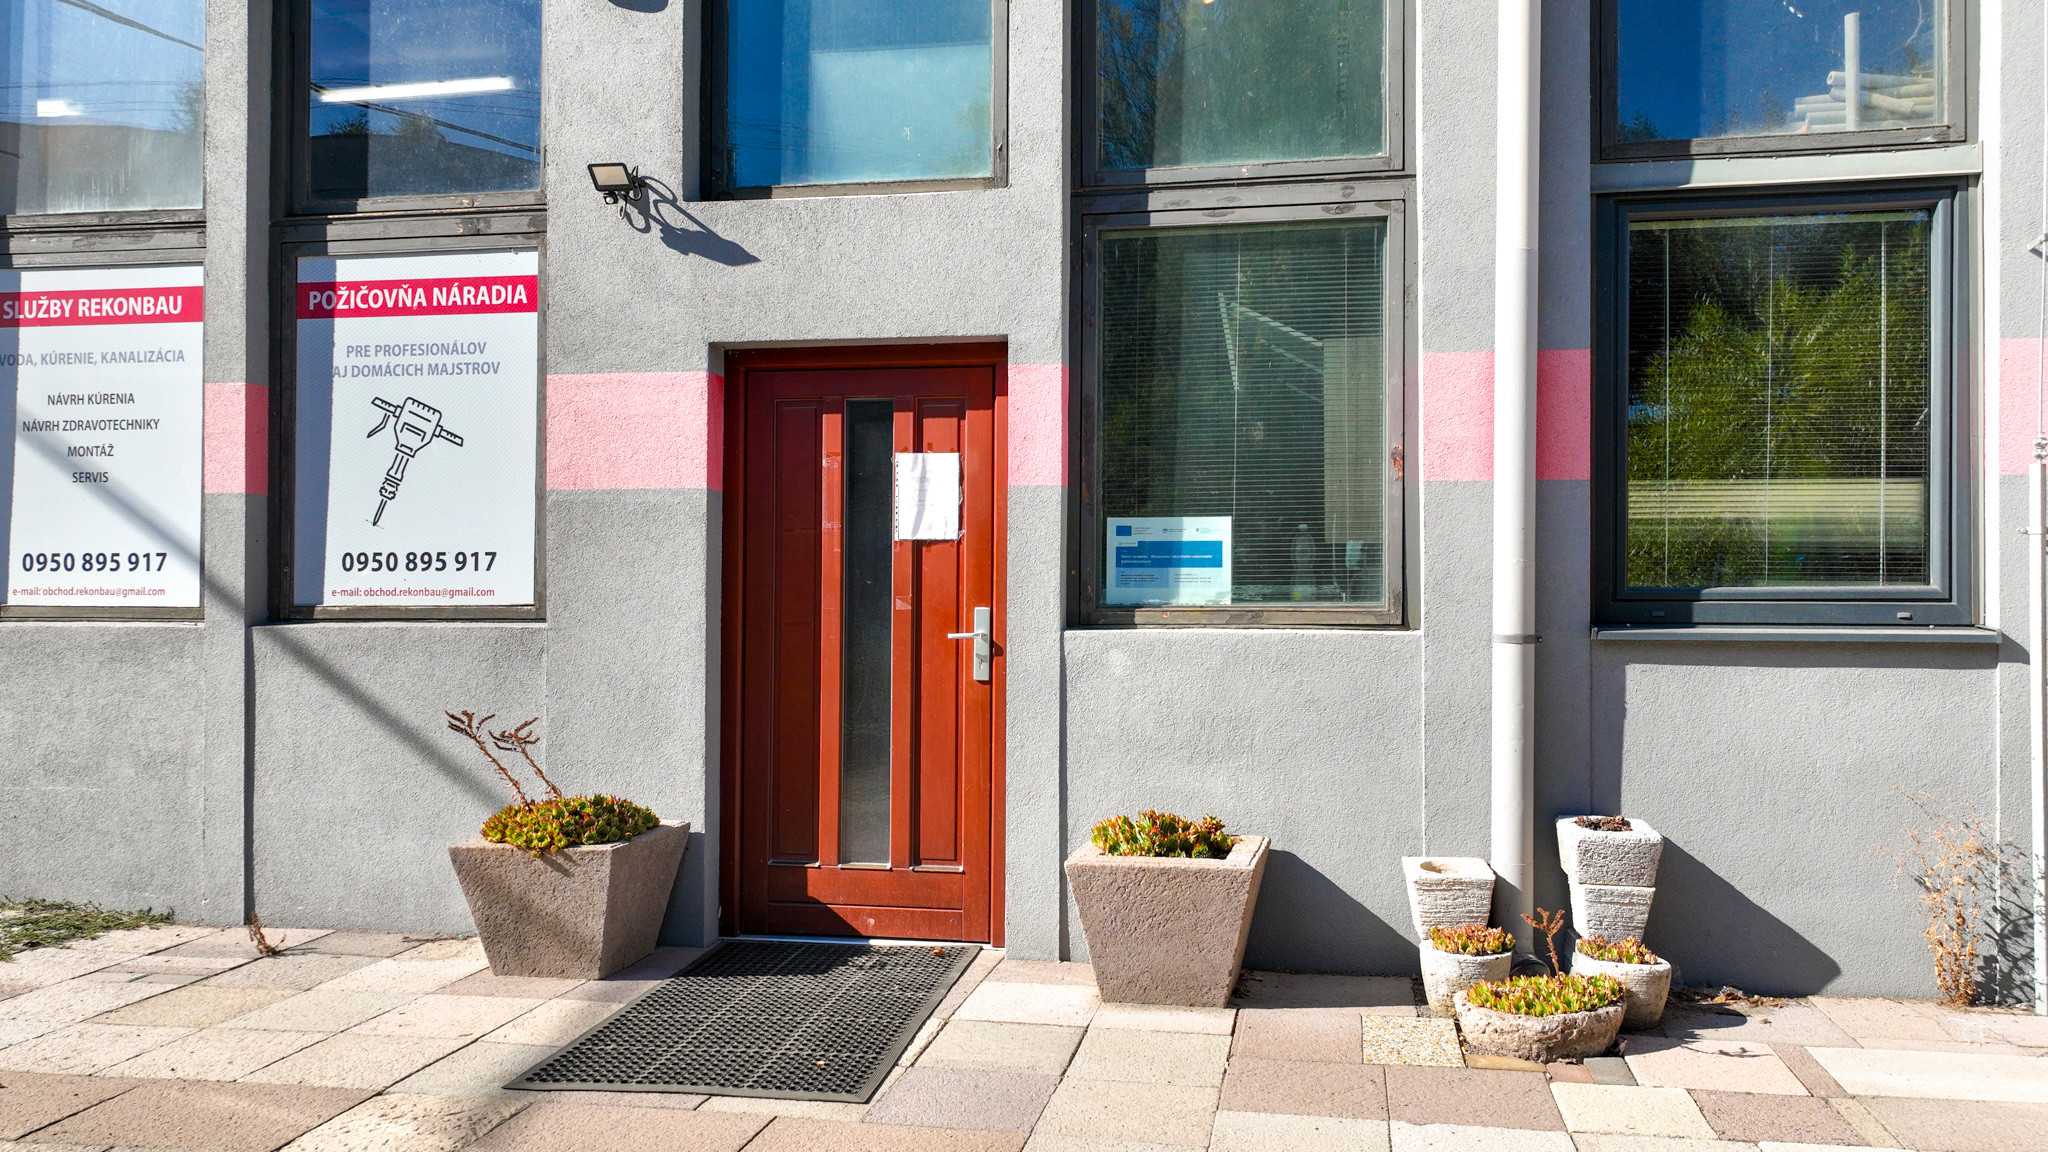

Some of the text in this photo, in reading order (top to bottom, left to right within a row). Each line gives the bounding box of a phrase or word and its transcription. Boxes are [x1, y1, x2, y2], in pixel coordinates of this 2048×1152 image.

[309, 282, 528, 311] POŽIČOVŇA NÁRADIA
[3, 295, 182, 320] SLUŽBY REKONBAU
[0, 348, 185, 367] VODA, KÚRENIE, KANALIZÁCIA
[346, 340, 487, 358] PRE PROFESIONÁLOV
[333, 361, 501, 378] AJ DOMÁCICH MAJSTROV
[47, 391, 135, 406] NÁVRH KÚRENIA
[22, 418, 160, 432] NÁVRH ZDRAVOTECHNIKY
[67, 443, 114, 457] MONTÁŽ
[72, 472, 109, 483] SERVIS
[22, 552, 167, 572] 0950 895 917
[342, 551, 497, 572] 0950 895 917
[12, 587, 166, 598] e-mail: obchod.rekonbau@gmail.com
[331, 587, 495, 599] e-mail: obchod.rekonbau@gmail.com
